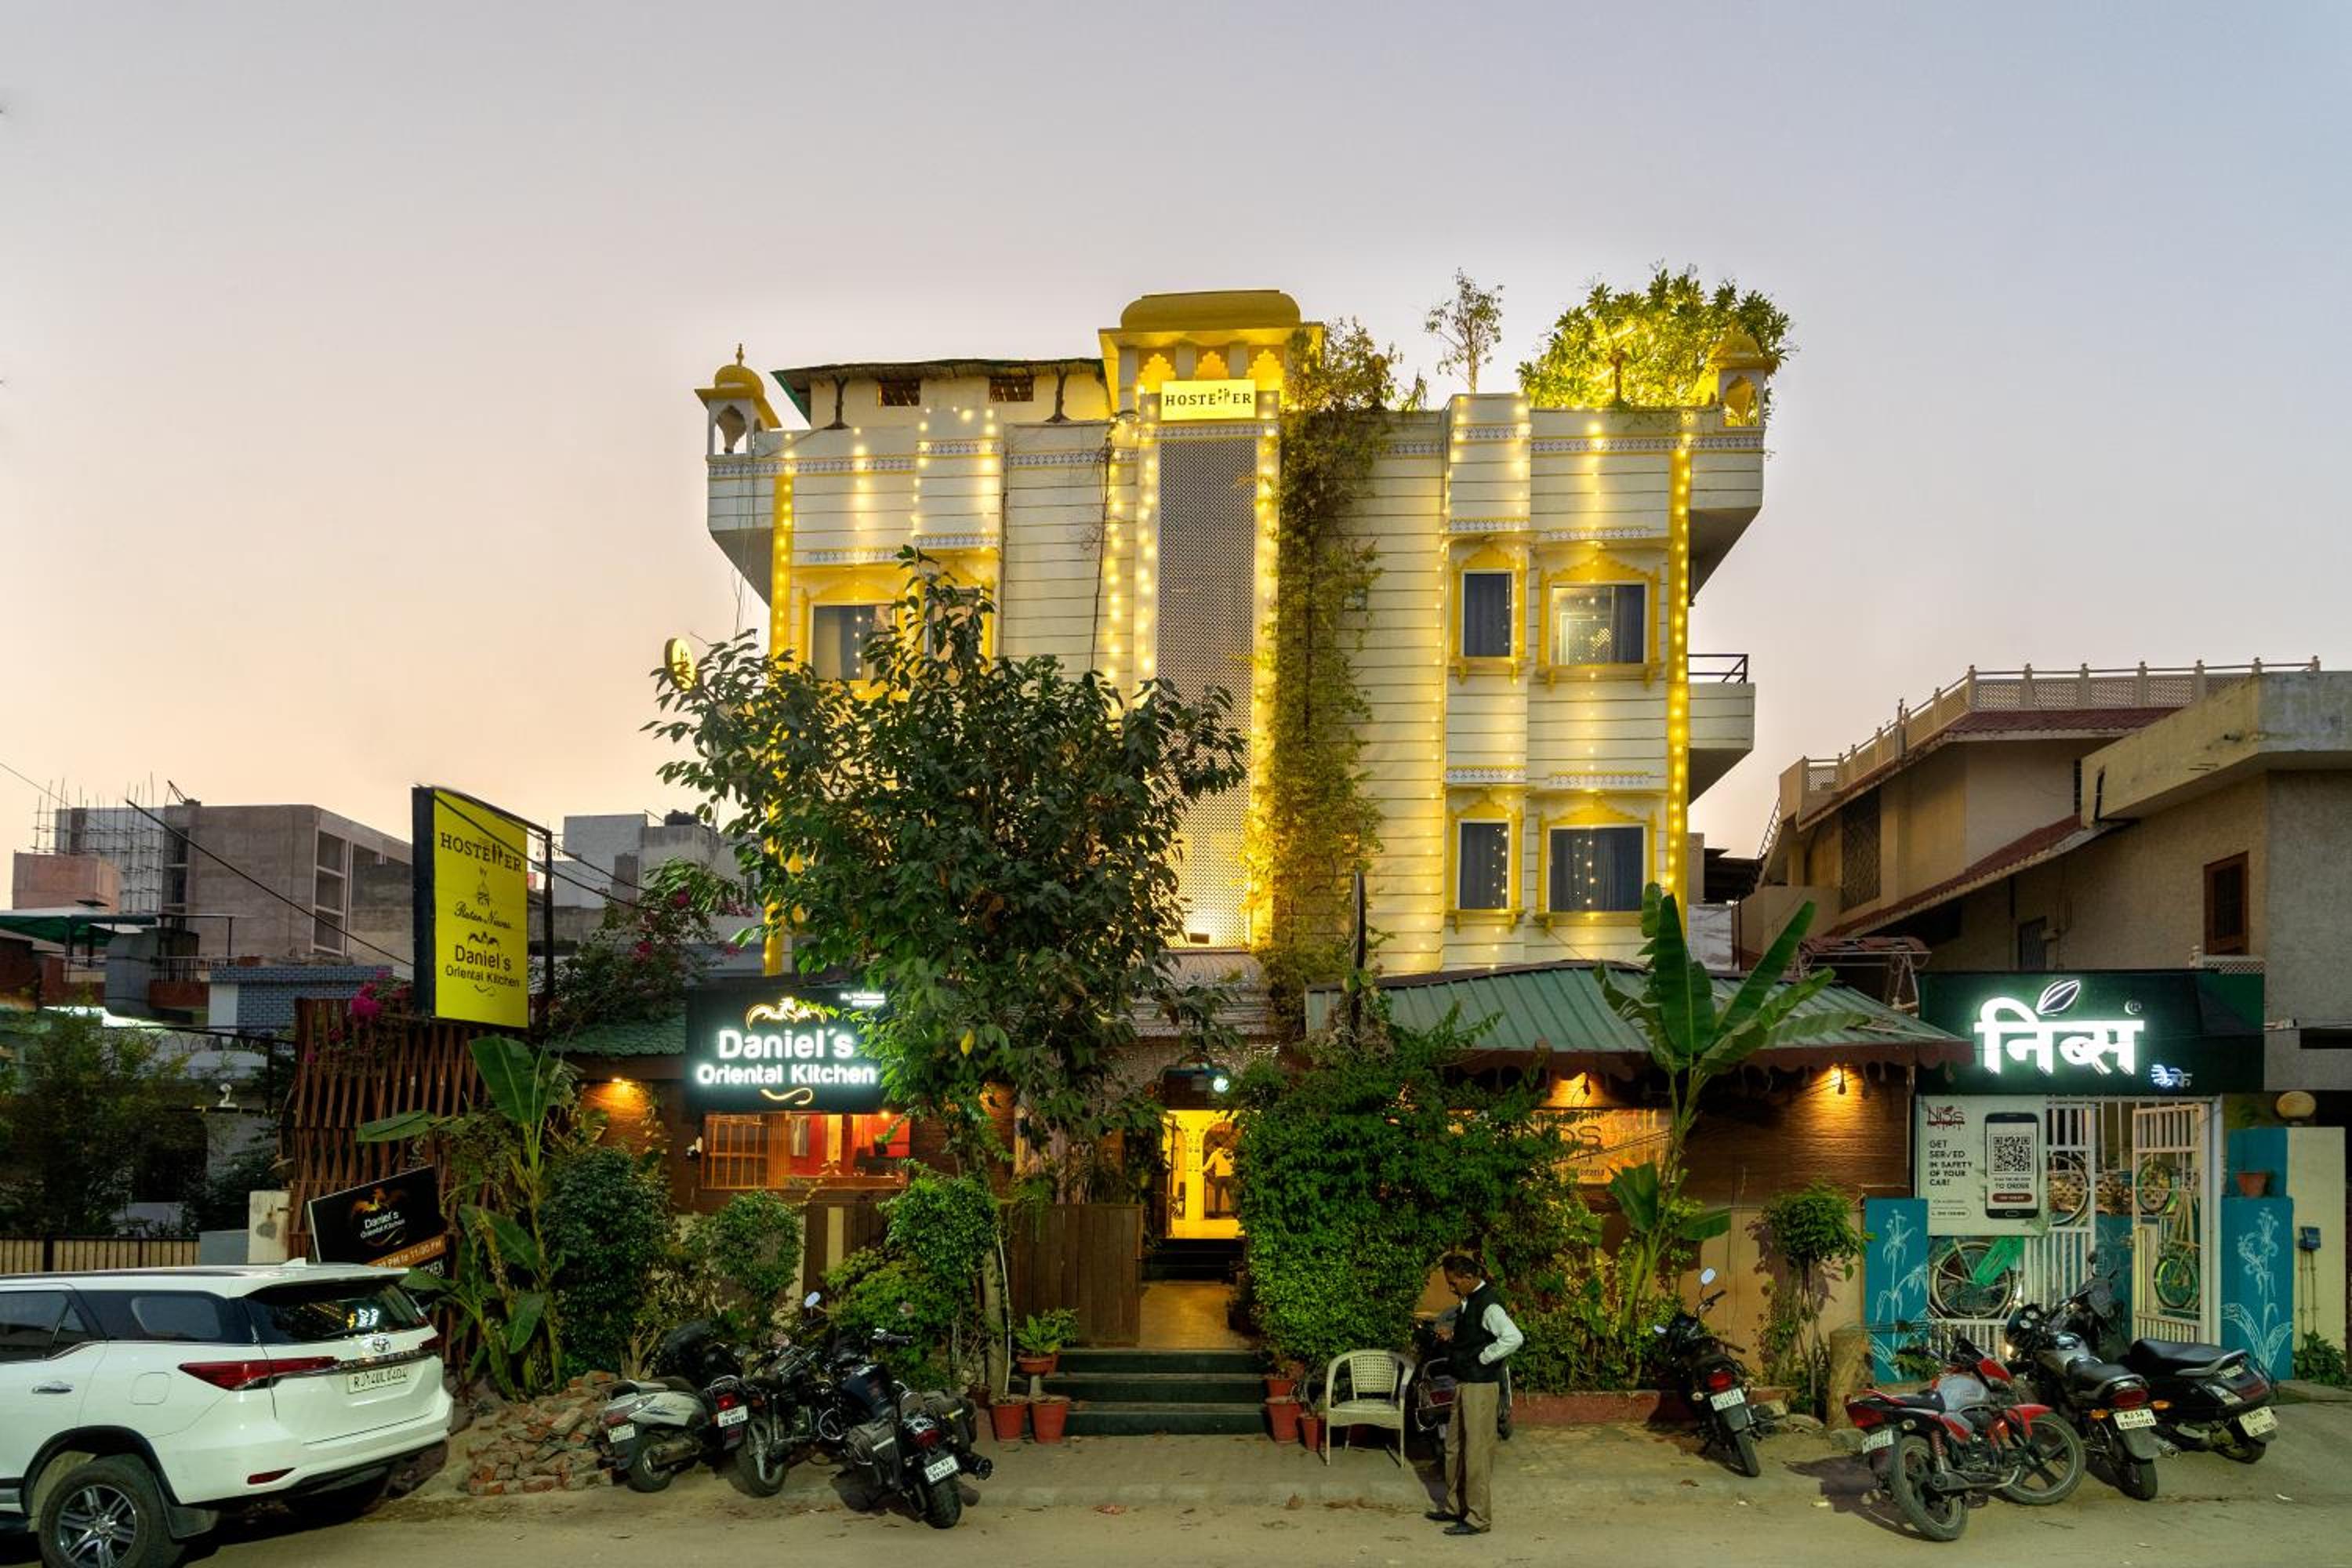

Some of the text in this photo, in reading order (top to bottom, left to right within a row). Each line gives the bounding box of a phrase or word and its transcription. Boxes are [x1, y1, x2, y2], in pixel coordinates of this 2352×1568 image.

[455, 945, 511, 971] Daniel's
[445, 964, 520, 988] Oriental Kitchen
[718, 1027, 855, 1059] Daniel's
[696, 1063, 877, 1085] Oriental Kitchen
[1929, 1139, 1947, 1149] GET
[1929, 1150, 1965, 1159] SERVED
